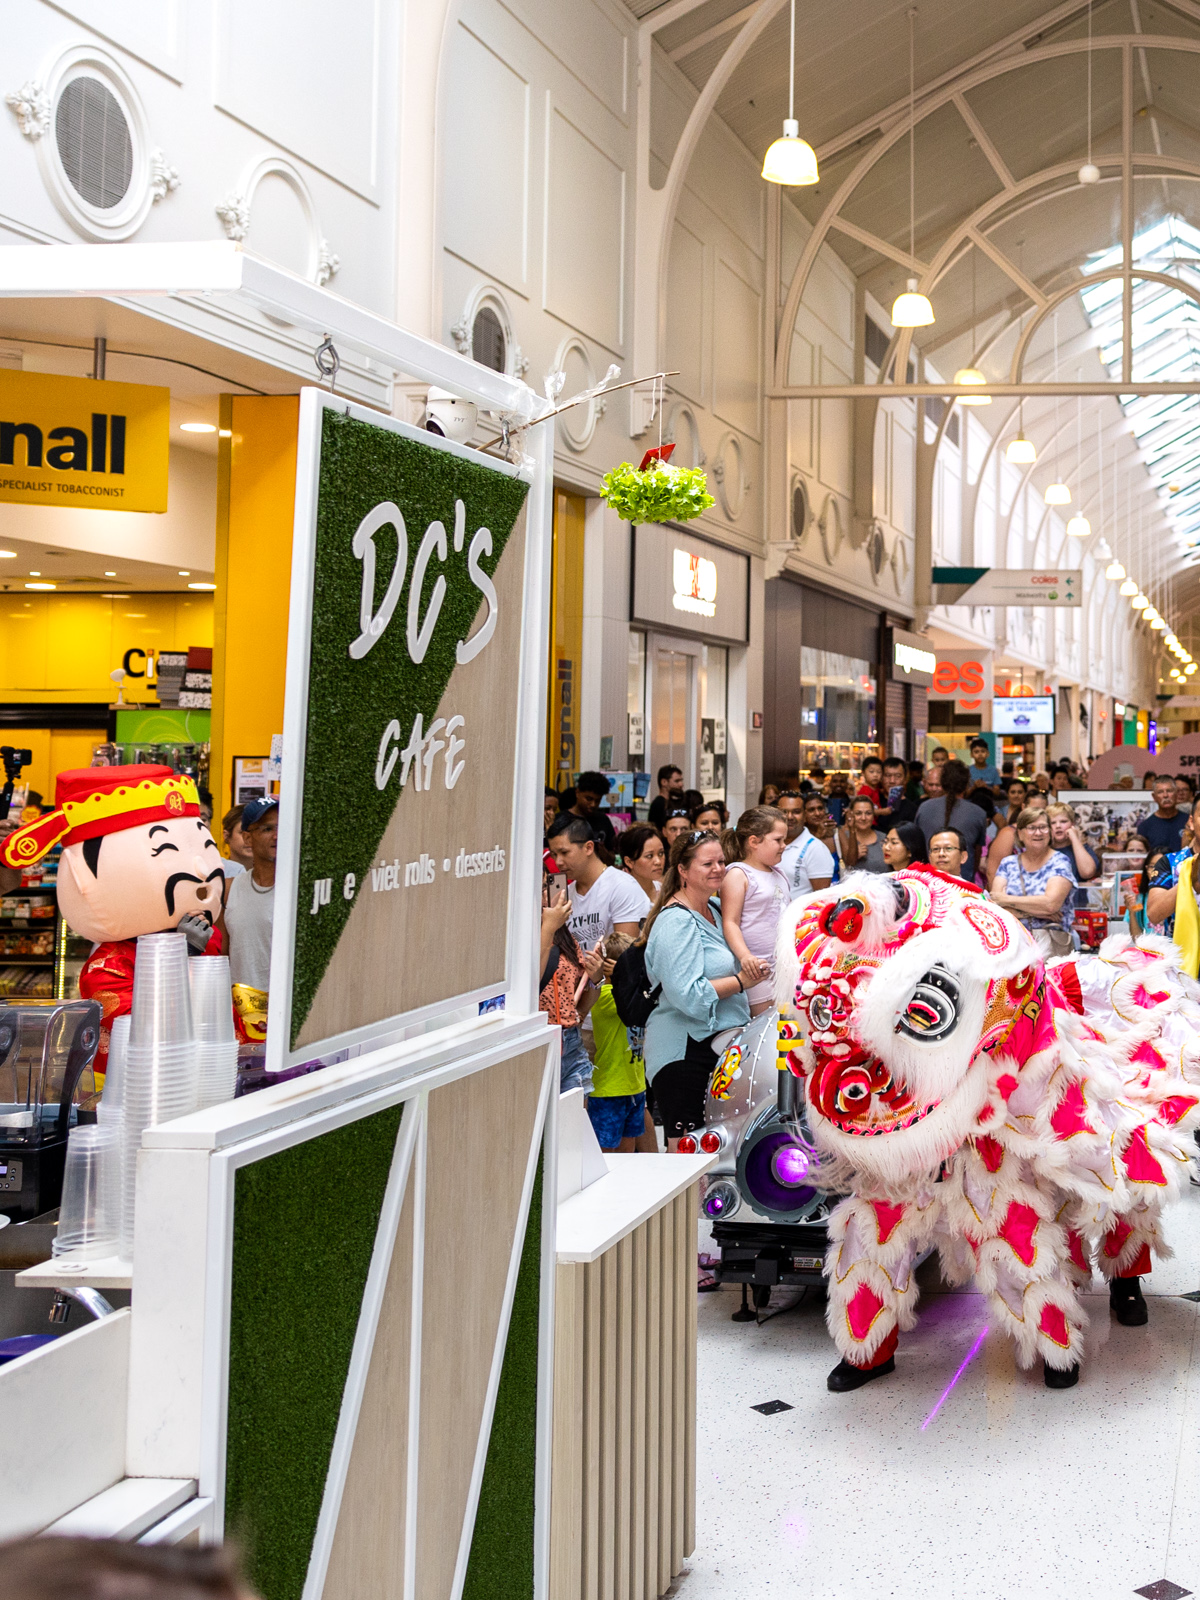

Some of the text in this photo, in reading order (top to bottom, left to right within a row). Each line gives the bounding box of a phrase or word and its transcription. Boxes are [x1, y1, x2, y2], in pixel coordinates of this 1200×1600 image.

[57, 483, 125, 497] TOBACCONIST
[349, 499, 498, 665] DC'S
[371, 859, 400, 892] viet
[405, 853, 436, 887] rolls
[455, 845, 506, 878] desserts
